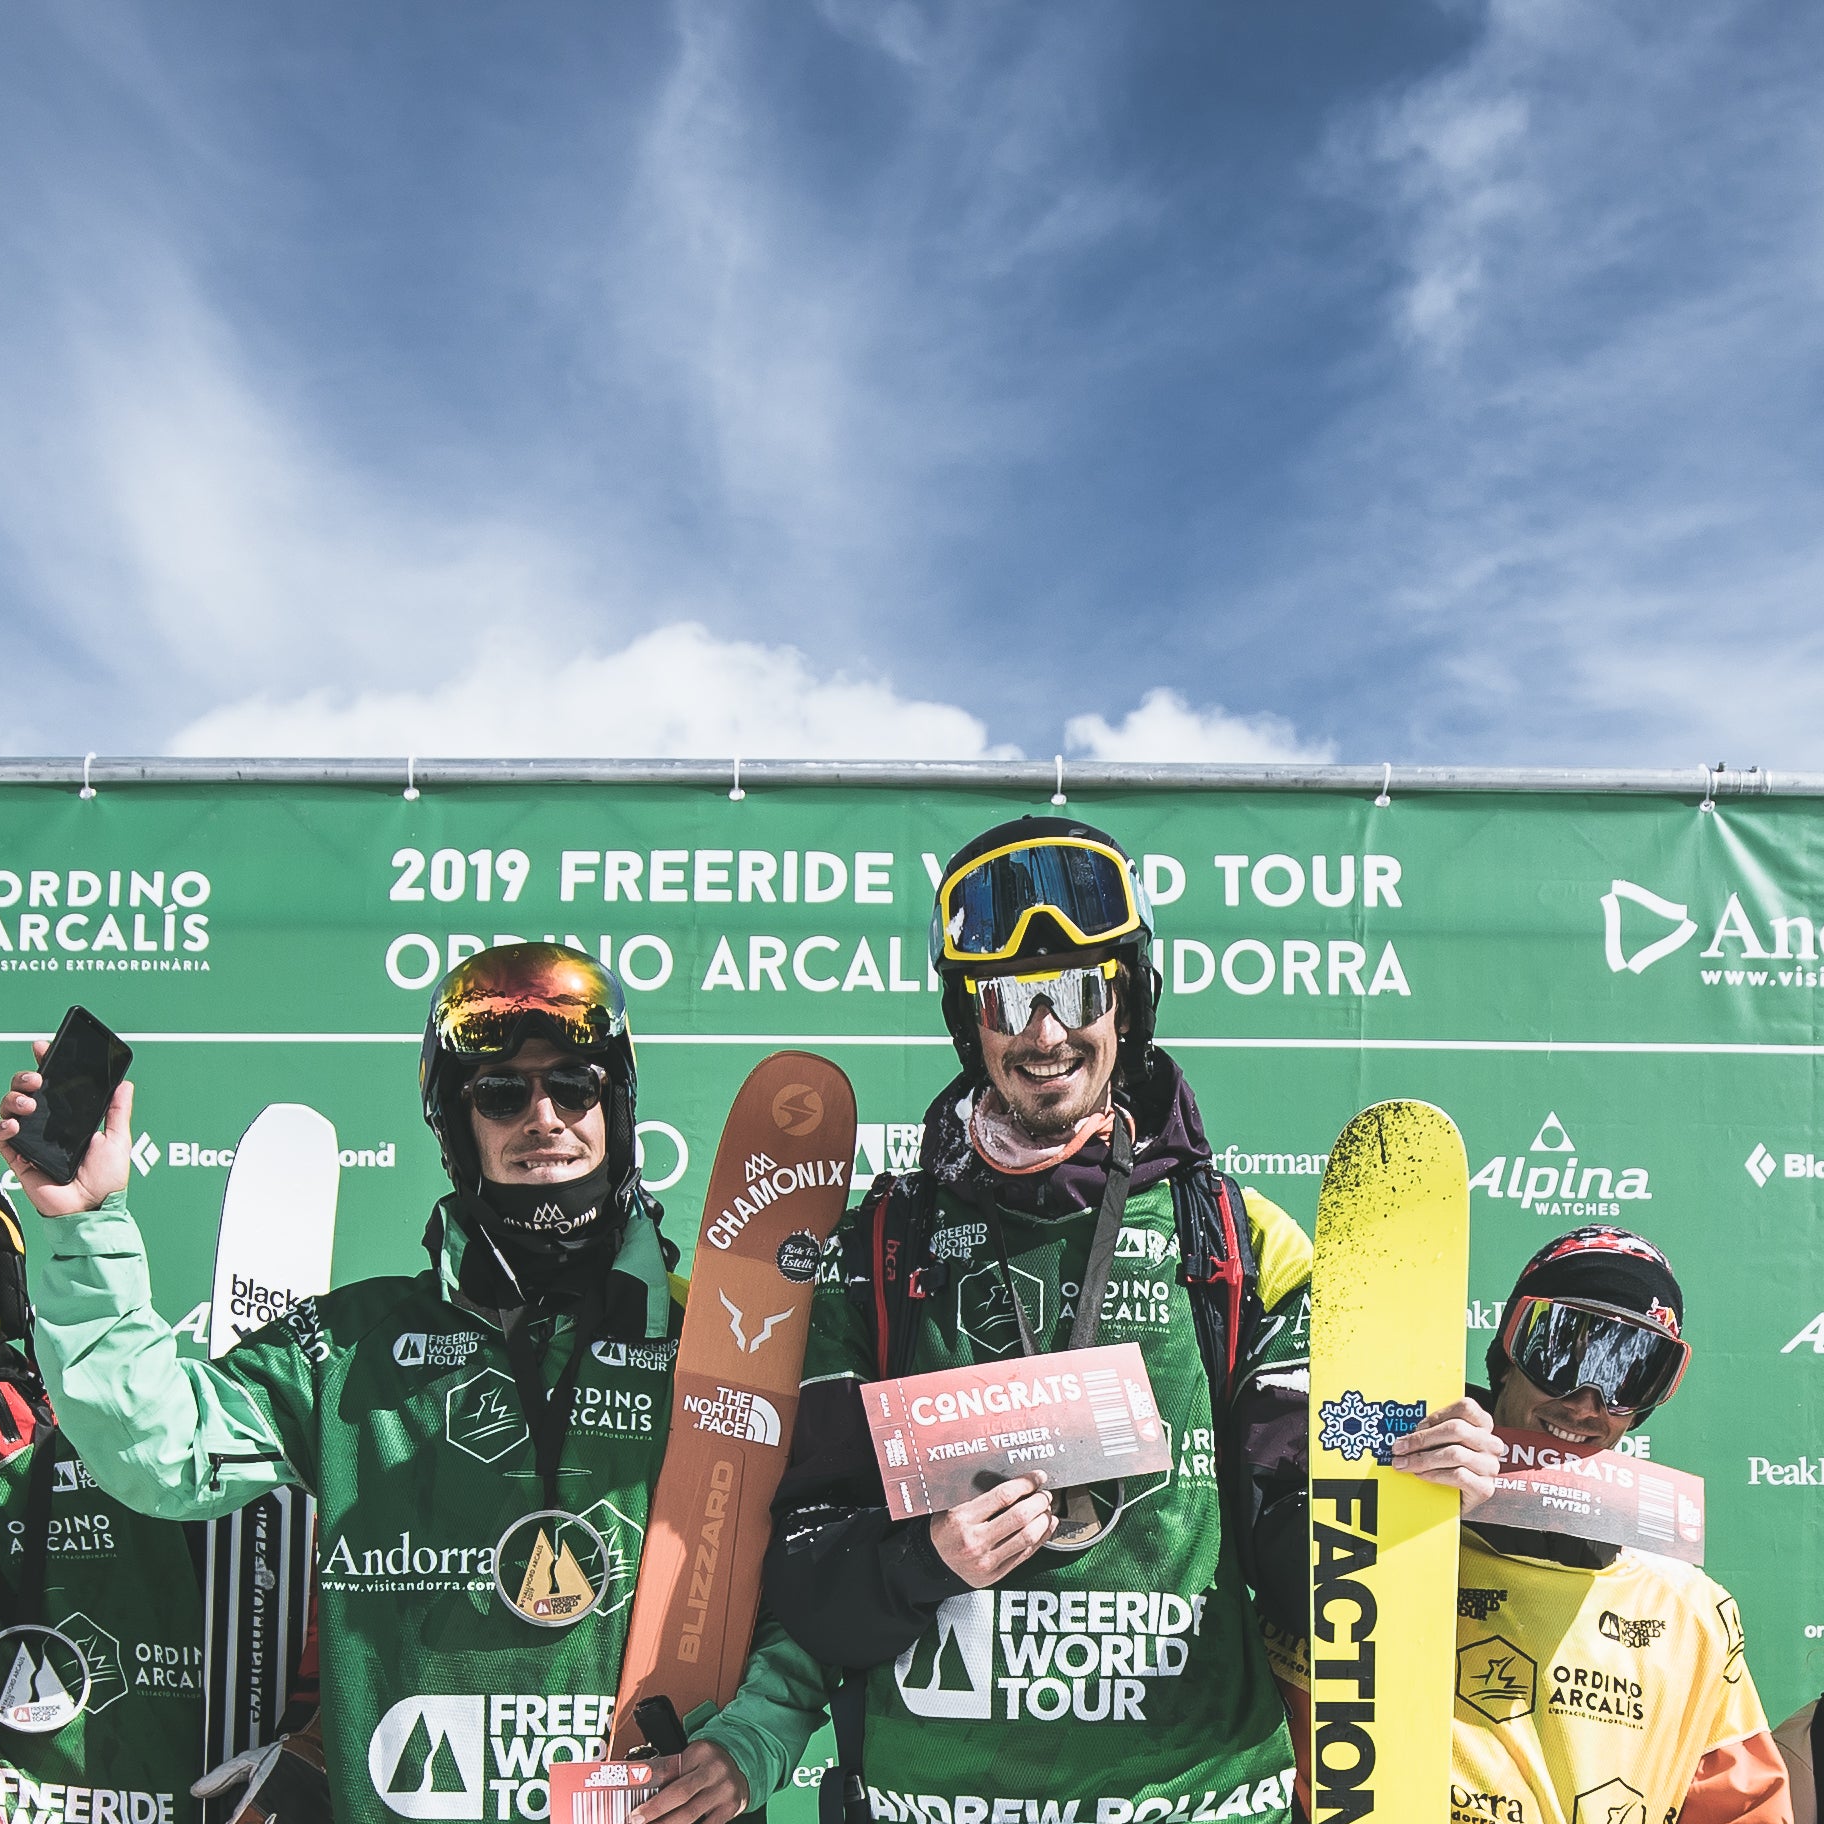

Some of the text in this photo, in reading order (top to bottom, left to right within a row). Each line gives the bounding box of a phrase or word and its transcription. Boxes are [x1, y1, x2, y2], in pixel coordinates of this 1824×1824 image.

[389, 847, 531, 903] 2019
[560, 850, 894, 903] FREERIDE
[1214, 855, 1403, 908] TOUR
[66, 957, 211, 972] EXTRAORDINÀRIA
[1468, 1156, 1653, 1205] Alpina
[706, 1160, 846, 1252] CHAMONIX
[1534, 1202, 1621, 1216] WATCHES
[780, 1255, 815, 1269] Estelle
[886, 1239, 901, 1281] bca
[231, 1274, 300, 1311] black
[427, 1353, 466, 1366] TOUR
[428, 1341, 478, 1355] WORLD
[628, 1358, 667, 1372] TOUR
[682, 1395, 750, 1422] NORTH
[716, 1386, 753, 1407] THE
[911, 1373, 1083, 1426] CONGRATS
[1385, 1404, 1424, 1418] Good
[699, 1415, 746, 1439] FACE
[926, 1426, 1052, 1463] XTREME VERBIER
[1008, 1446, 1056, 1466] FWT20
[1531, 1482, 1591, 1503] VERBIER
[1543, 1497, 1591, 1515] FWT20
[321, 1533, 496, 1575] Andorra
[677, 1460, 734, 1663] BLIZZARD
[999, 1635, 1190, 1676] WORLD
[1553, 1665, 1643, 1699] ORDINO
[997, 1677, 1147, 1722] TOUR
[1548, 1686, 1645, 1721] ARCALÍS
